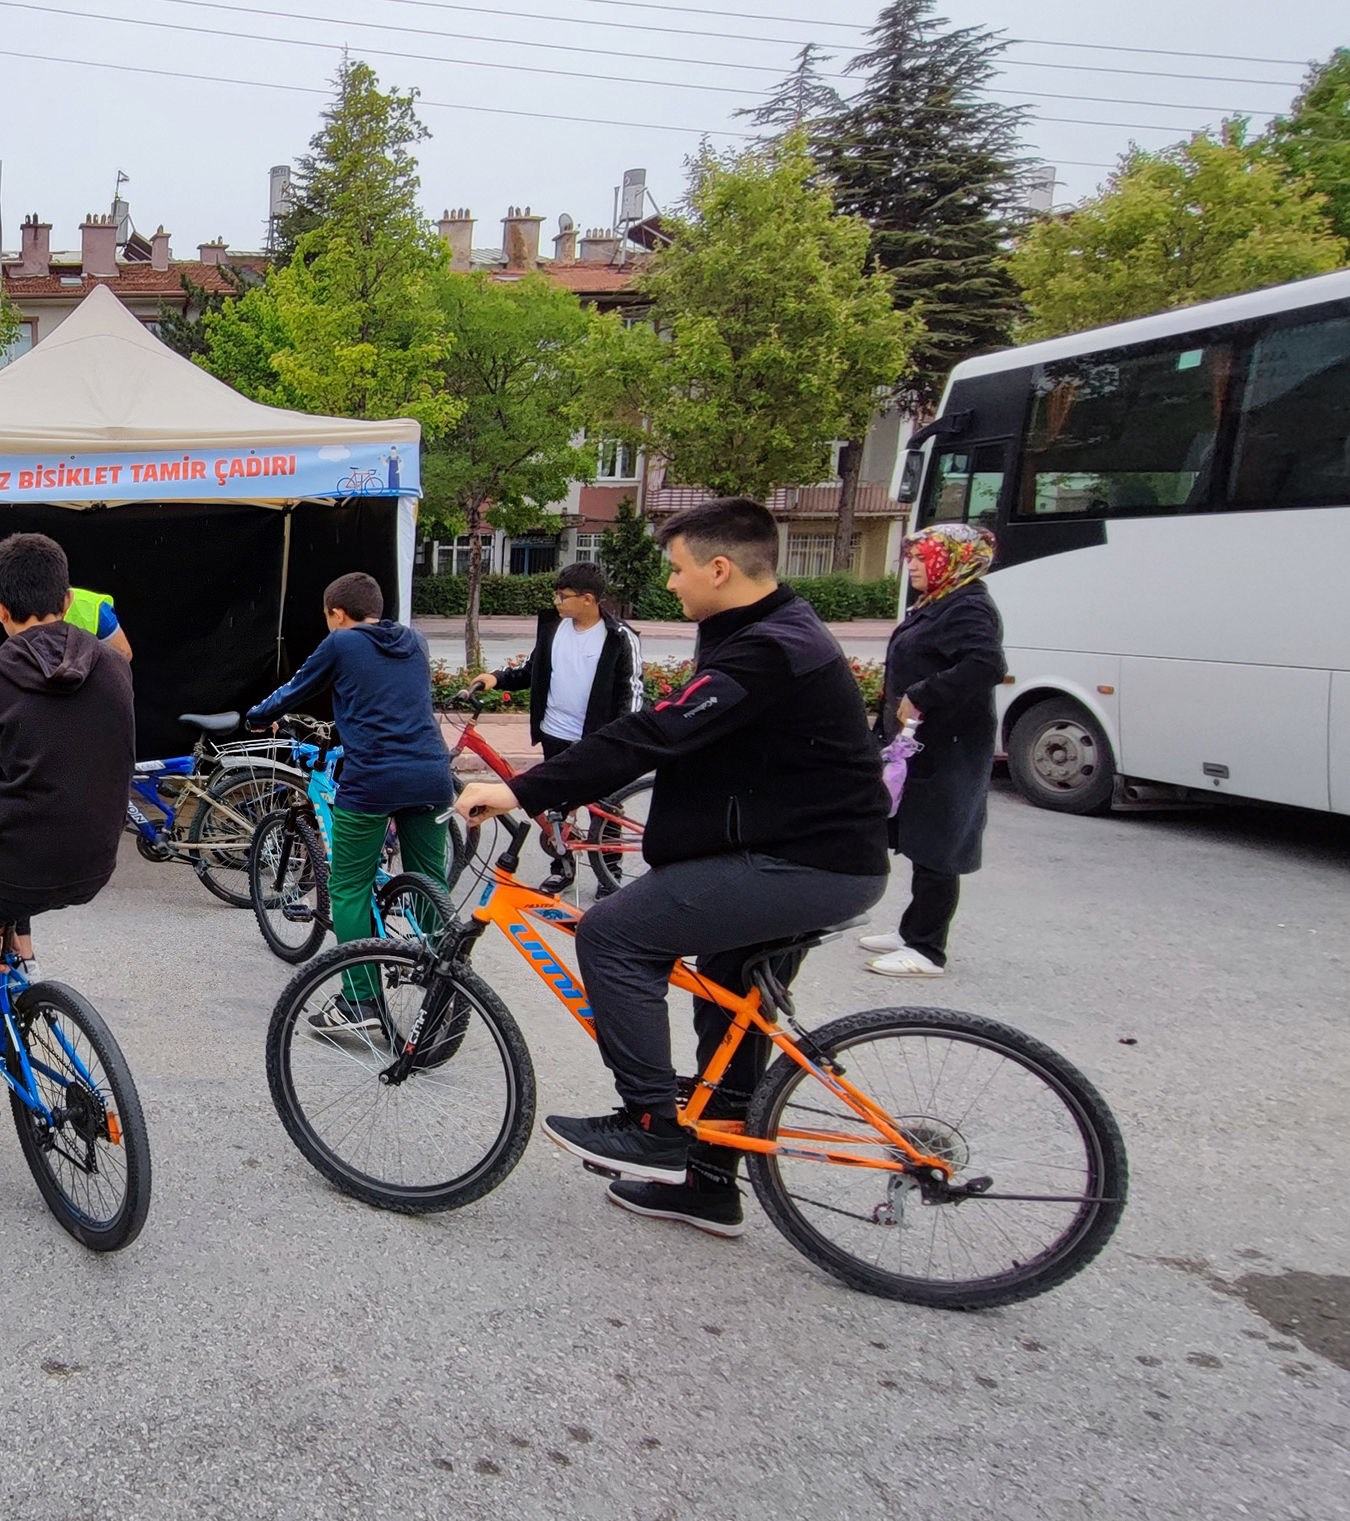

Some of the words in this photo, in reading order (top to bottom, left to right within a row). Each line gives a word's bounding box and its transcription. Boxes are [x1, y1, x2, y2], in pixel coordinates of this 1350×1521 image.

[18, 463, 123, 489] BİSİKLET
[130, 455, 206, 483] TAMİR
[214, 455, 296, 486] ÇADIRI
